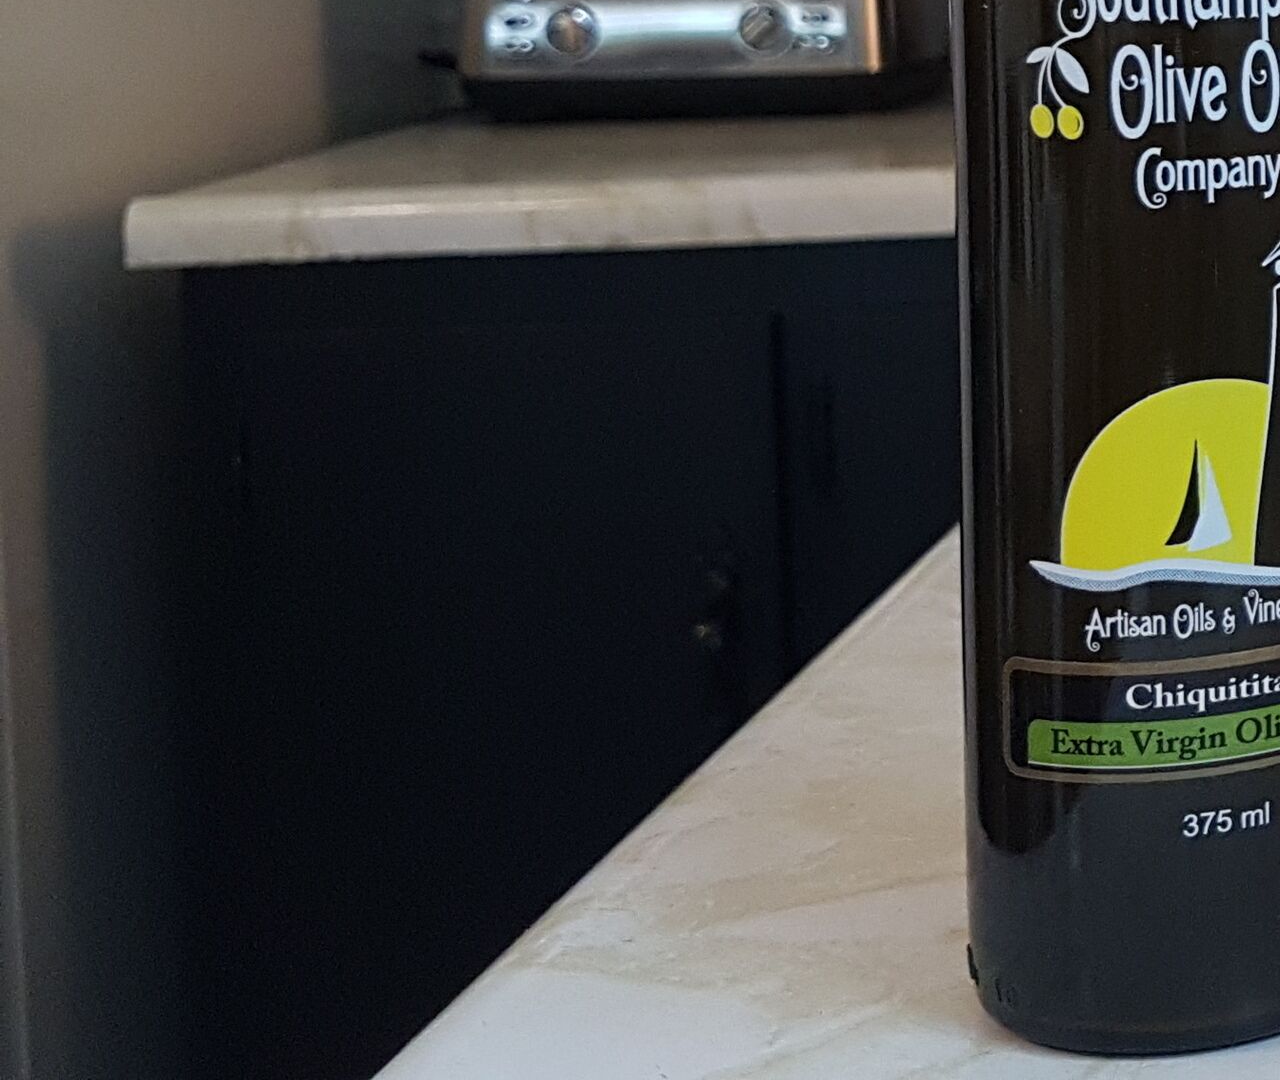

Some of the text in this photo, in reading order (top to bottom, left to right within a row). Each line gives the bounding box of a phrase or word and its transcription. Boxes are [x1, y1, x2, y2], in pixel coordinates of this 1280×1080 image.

[1111, 44, 1227, 140] Olive
[1085, 607, 1166, 653] Artisan
[1173, 602, 1216, 639] Oils
[1222, 607, 1236, 635] &
[1050, 728, 1125, 757] Extra
[1130, 726, 1227, 762] Virgin
[1183, 801, 1271, 838] 375 ml
